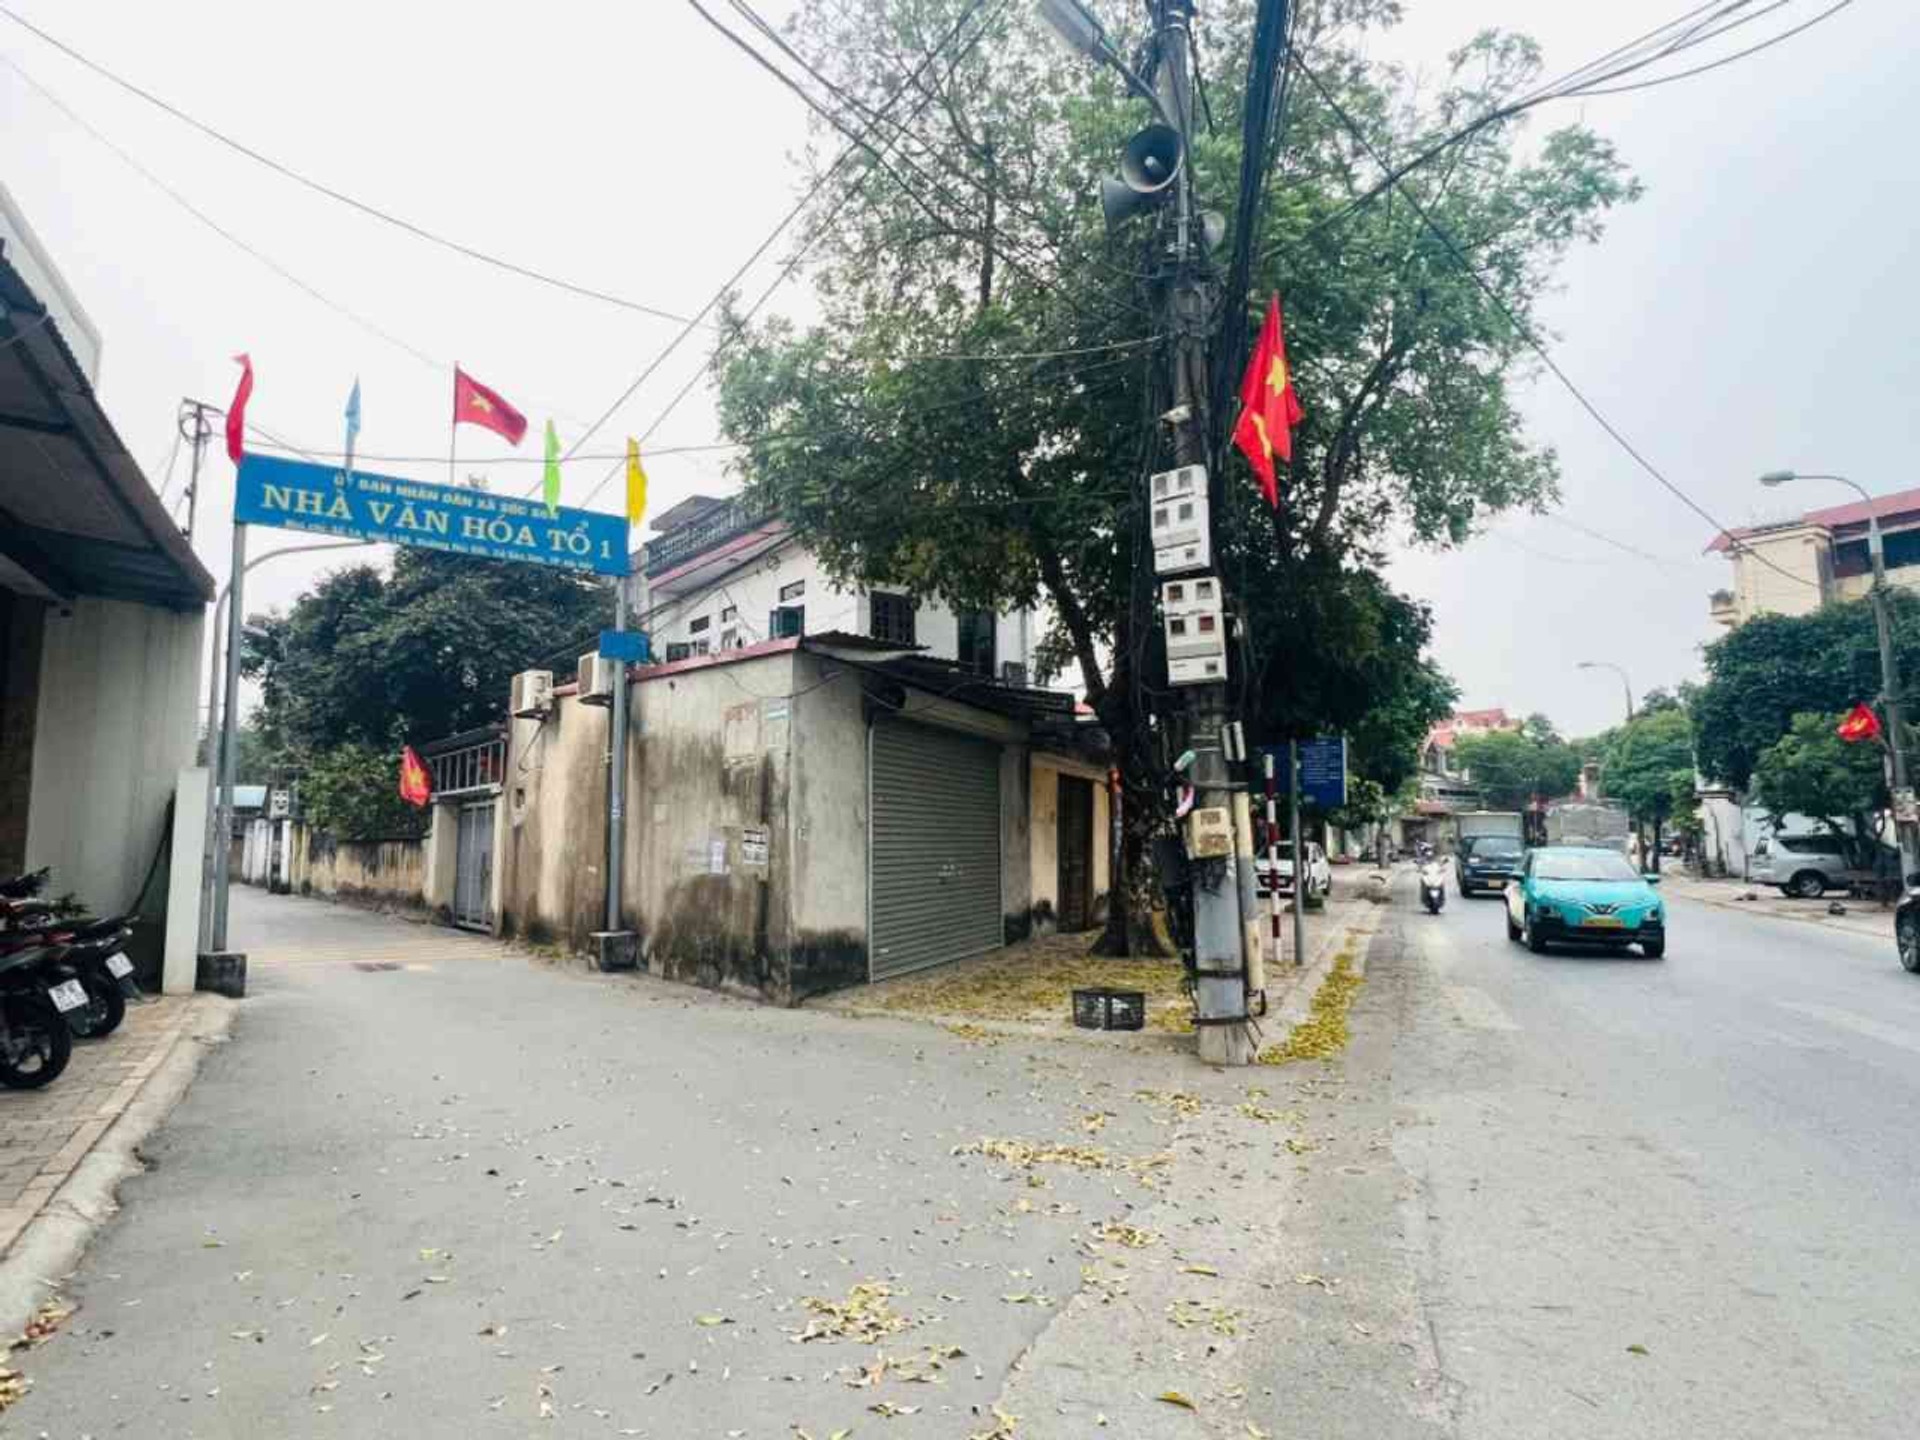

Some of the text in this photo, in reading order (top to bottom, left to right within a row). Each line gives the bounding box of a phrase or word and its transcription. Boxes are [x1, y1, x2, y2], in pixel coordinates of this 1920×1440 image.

[358, 479, 392, 494] BAN
[396, 484, 439, 501] NHÂN
[260, 482, 353, 521] NHÀ
[368, 500, 449, 535] VĂN
[462, 512, 537, 547] HÓA
[547, 519, 591, 555] TỔ
[600, 539, 611, 559] 1
